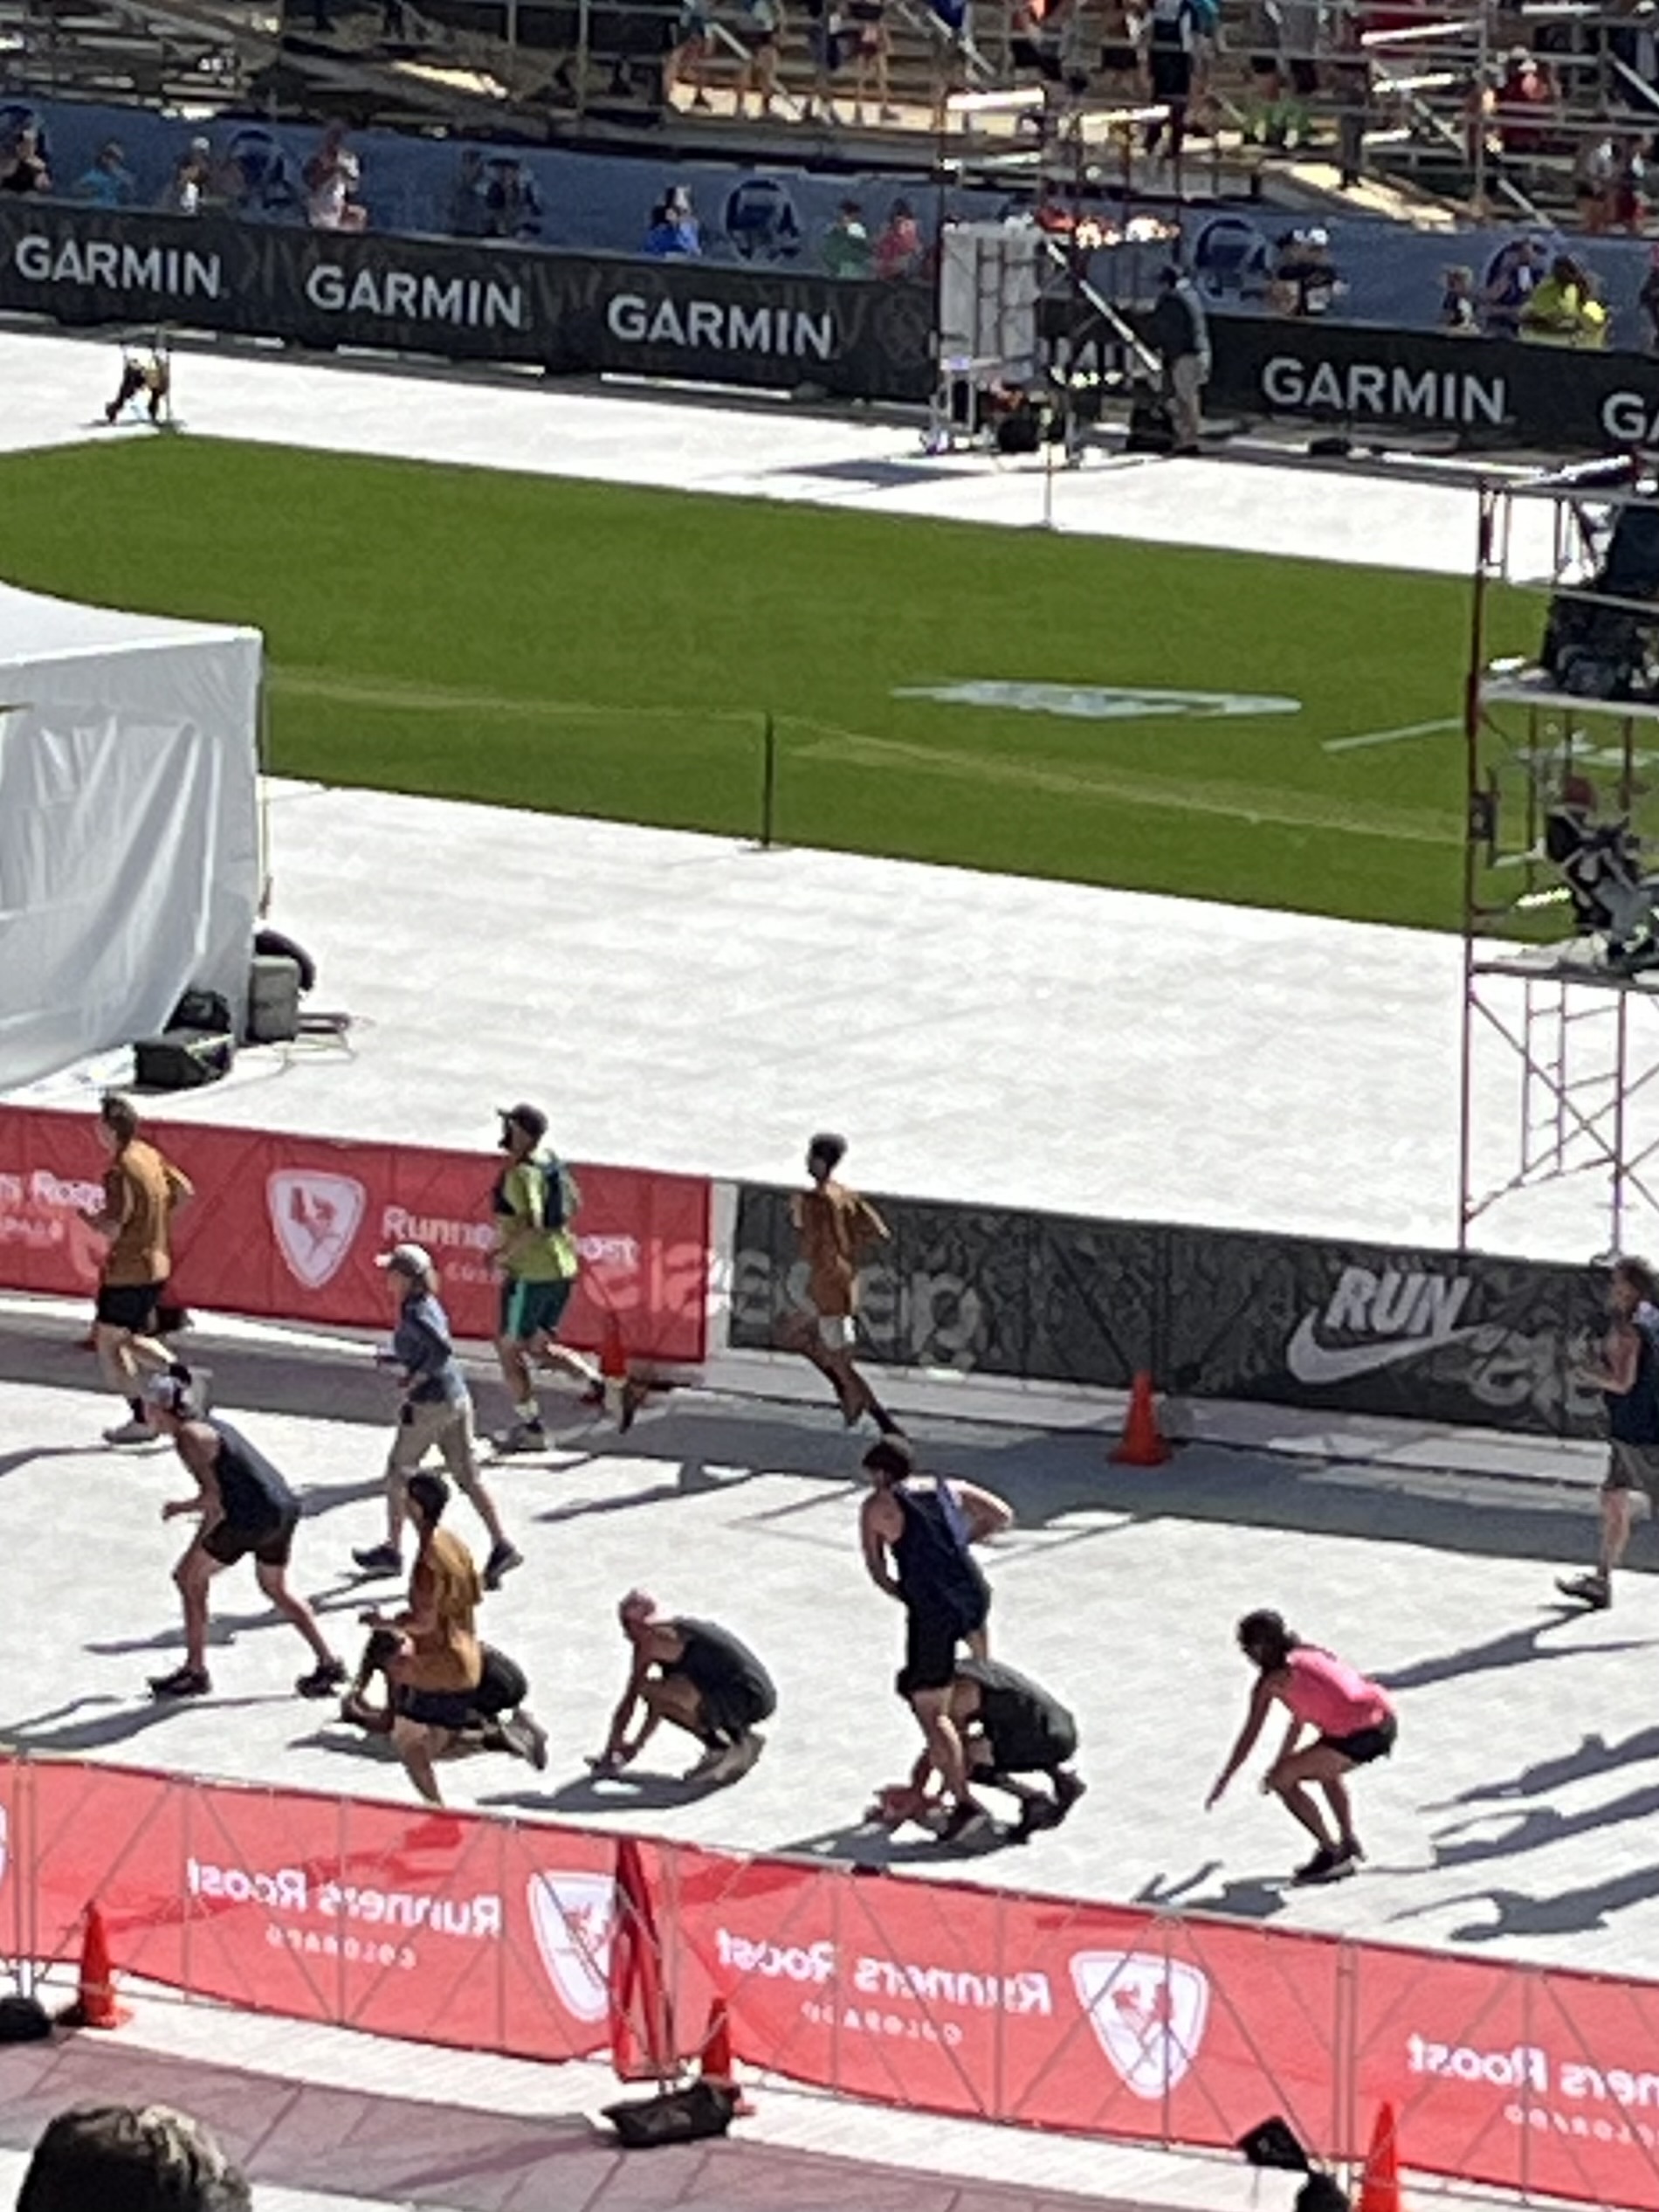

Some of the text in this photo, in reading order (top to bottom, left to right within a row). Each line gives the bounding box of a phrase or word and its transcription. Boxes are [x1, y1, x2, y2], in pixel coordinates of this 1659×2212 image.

[15, 233, 221, 299] GARMIN
[306, 264, 521, 329] GARMIN
[607, 293, 832, 361] GARMIN
[1262, 357, 1506, 424] GARMIN
[382, 1204, 641, 1267] Runne ost
[1325, 1266, 1472, 1336] RUN
